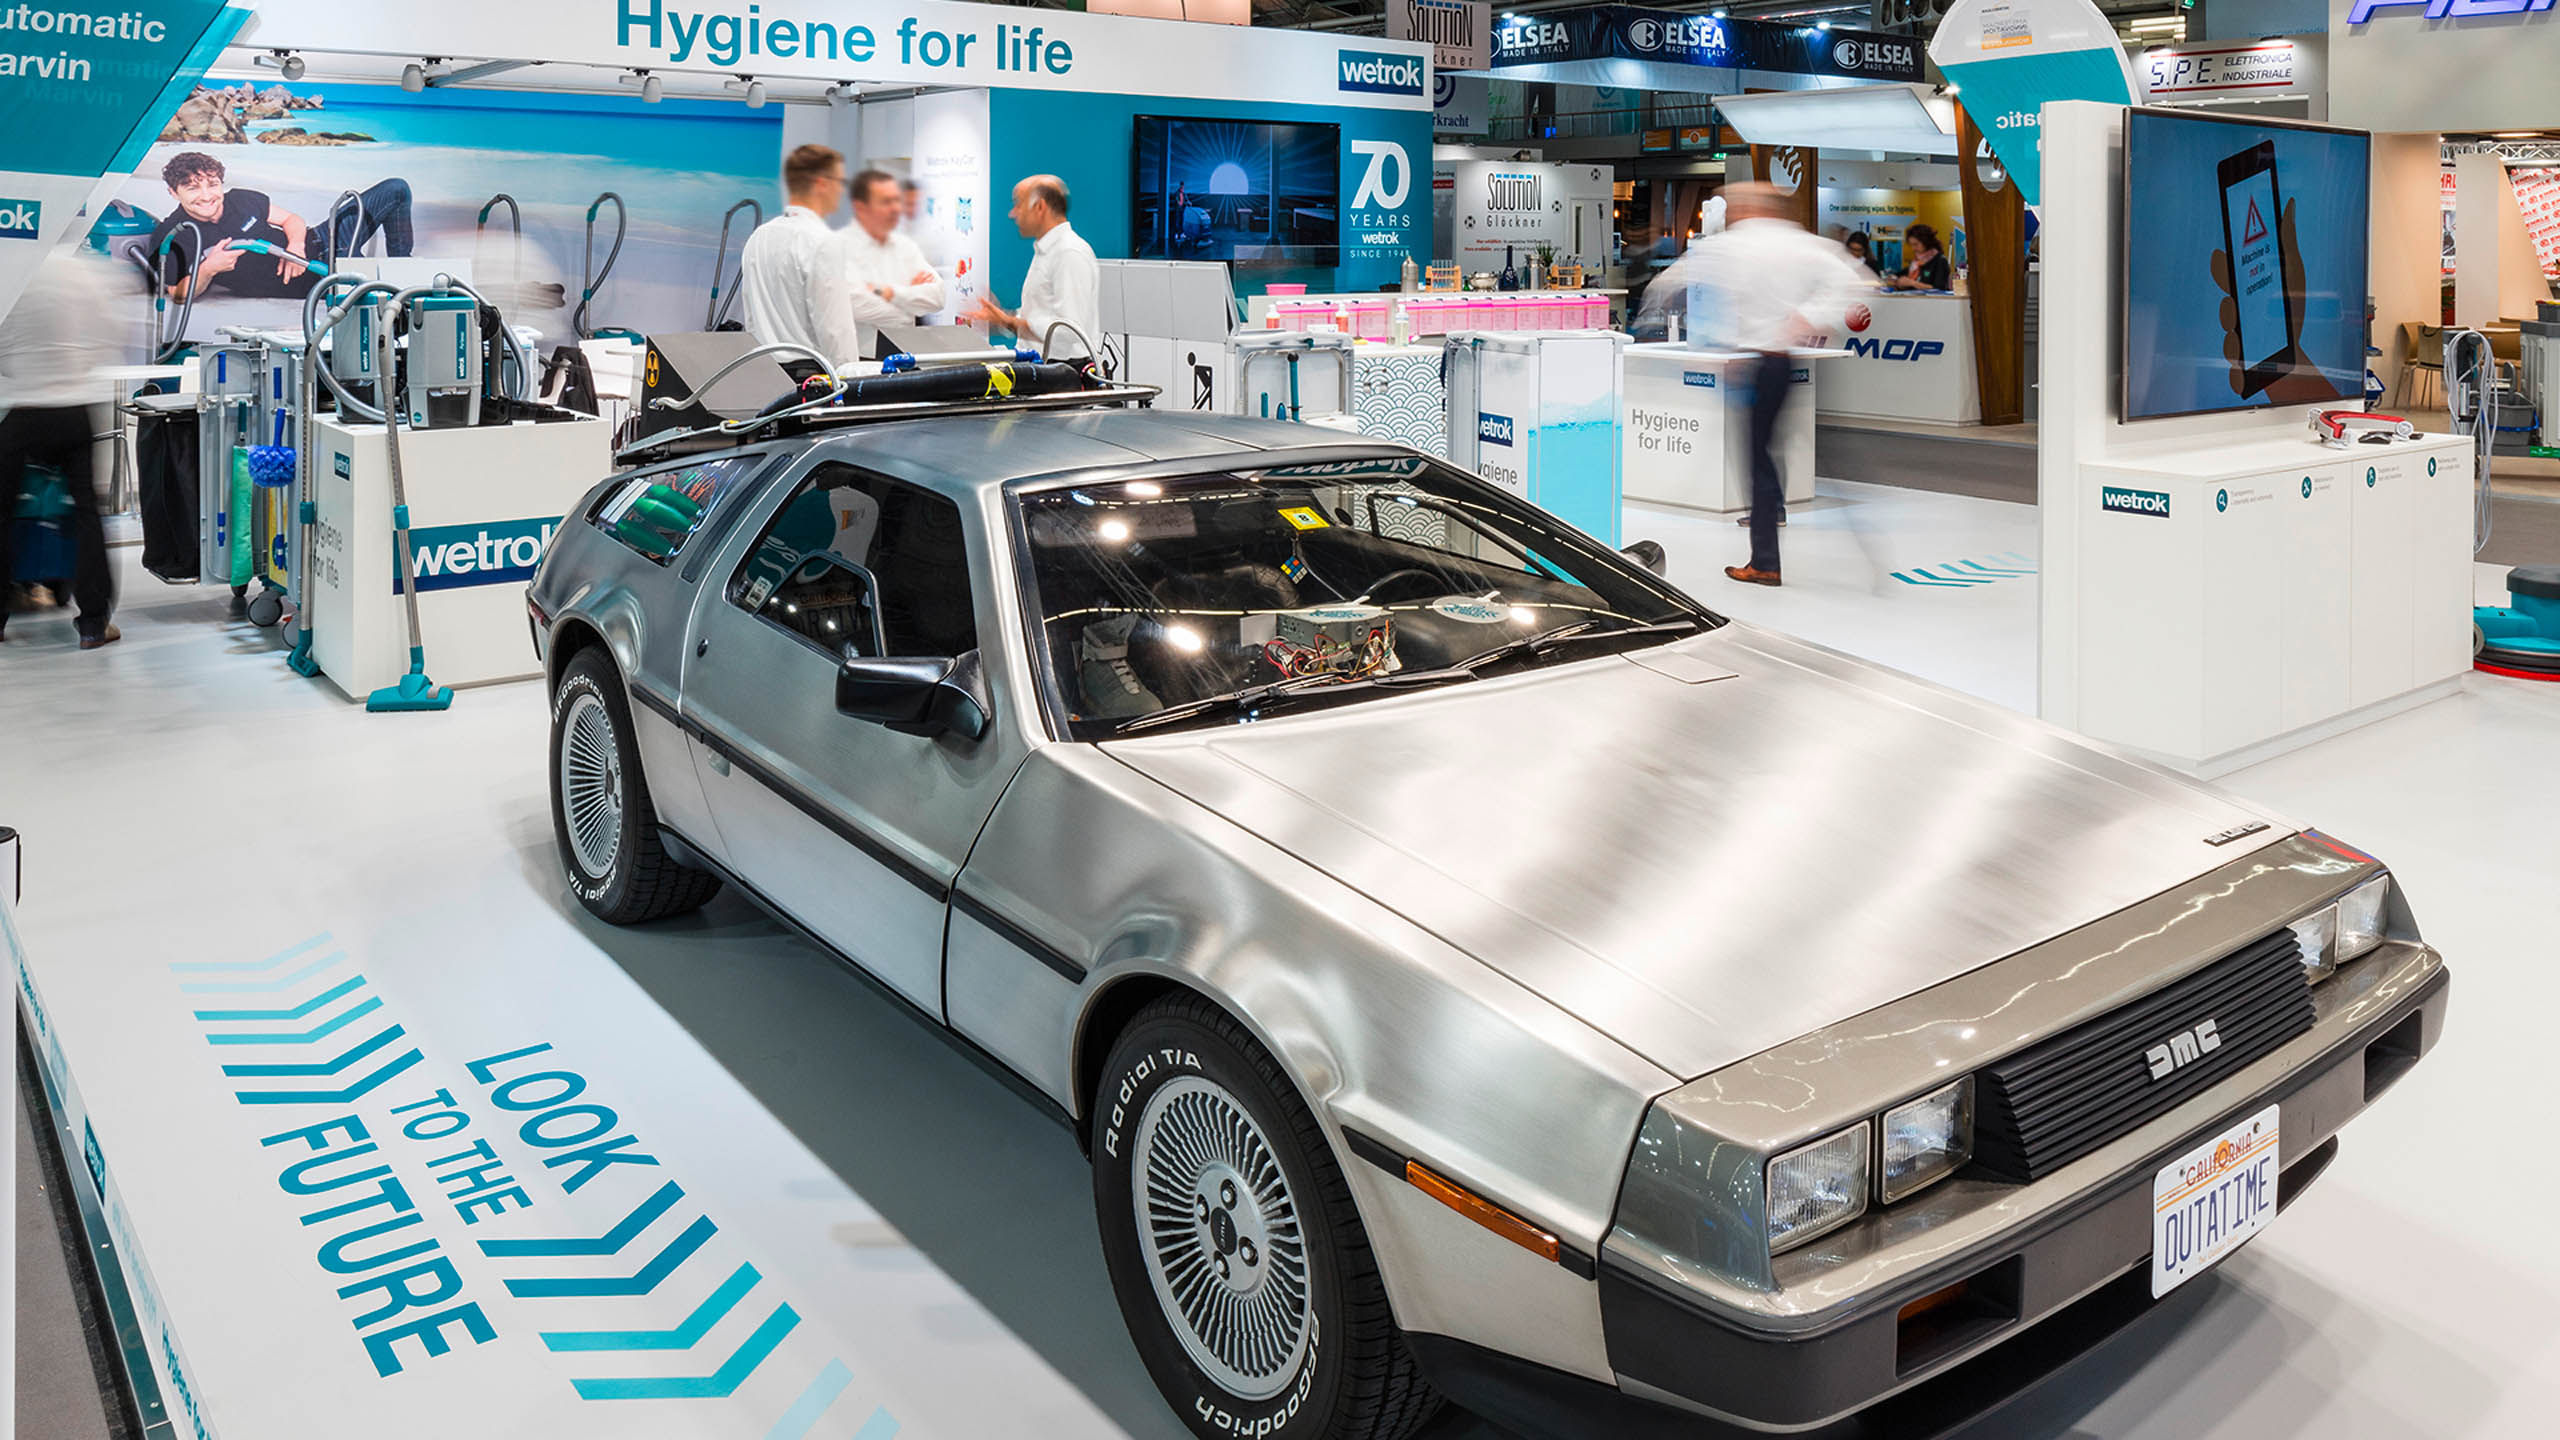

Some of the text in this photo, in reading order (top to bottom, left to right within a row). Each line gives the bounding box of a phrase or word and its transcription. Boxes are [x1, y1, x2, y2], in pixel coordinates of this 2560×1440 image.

[616, 0, 1074, 75] Hygiene for life
[1502, 22, 1569, 49] ELSEA
[1665, 22, 1726, 49] ELSEA
[1434, 50, 1473, 67] ckner
[1502, 44, 1570, 57] MADE IN ITALY
[1665, 45, 1726, 57] MADE IN ITALY
[1864, 42, 1914, 66] ELSEA
[2225, 53, 2293, 67] ELETTRONICA
[1342, 58, 1421, 87] wetrok
[1864, 62, 1914, 73] MADE IN ITALY
[2222, 68, 2292, 82] INDUSTRIALE
[1433, 114, 1469, 127] rkracht
[1351, 140, 1410, 209] 70
[1350, 214, 1410, 227] YEARS
[1487, 215, 1542, 228] Glöckner
[1362, 231, 1399, 245] wetrok
[1350, 250, 1381, 259] SINCE
[1632, 408, 1700, 433] Hygiene
[1638, 432, 1692, 455] for life
[1480, 460, 1518, 485] giene
[2105, 492, 2168, 513] wetrok
[2146, 1018, 2221, 1080] DMC
[1106, 1048, 1204, 1159] Radial T/A
[464, 1042, 660, 1195] LOOK
[390, 1087, 534, 1226] TO THE
[2186, 1131, 2252, 1187] CALIFORNIA
[2165, 1156, 2270, 1272] OUTATIME
[259, 1114, 498, 1378] FUTURE
[1195, 1309, 1320, 1440] BFGoodrich
